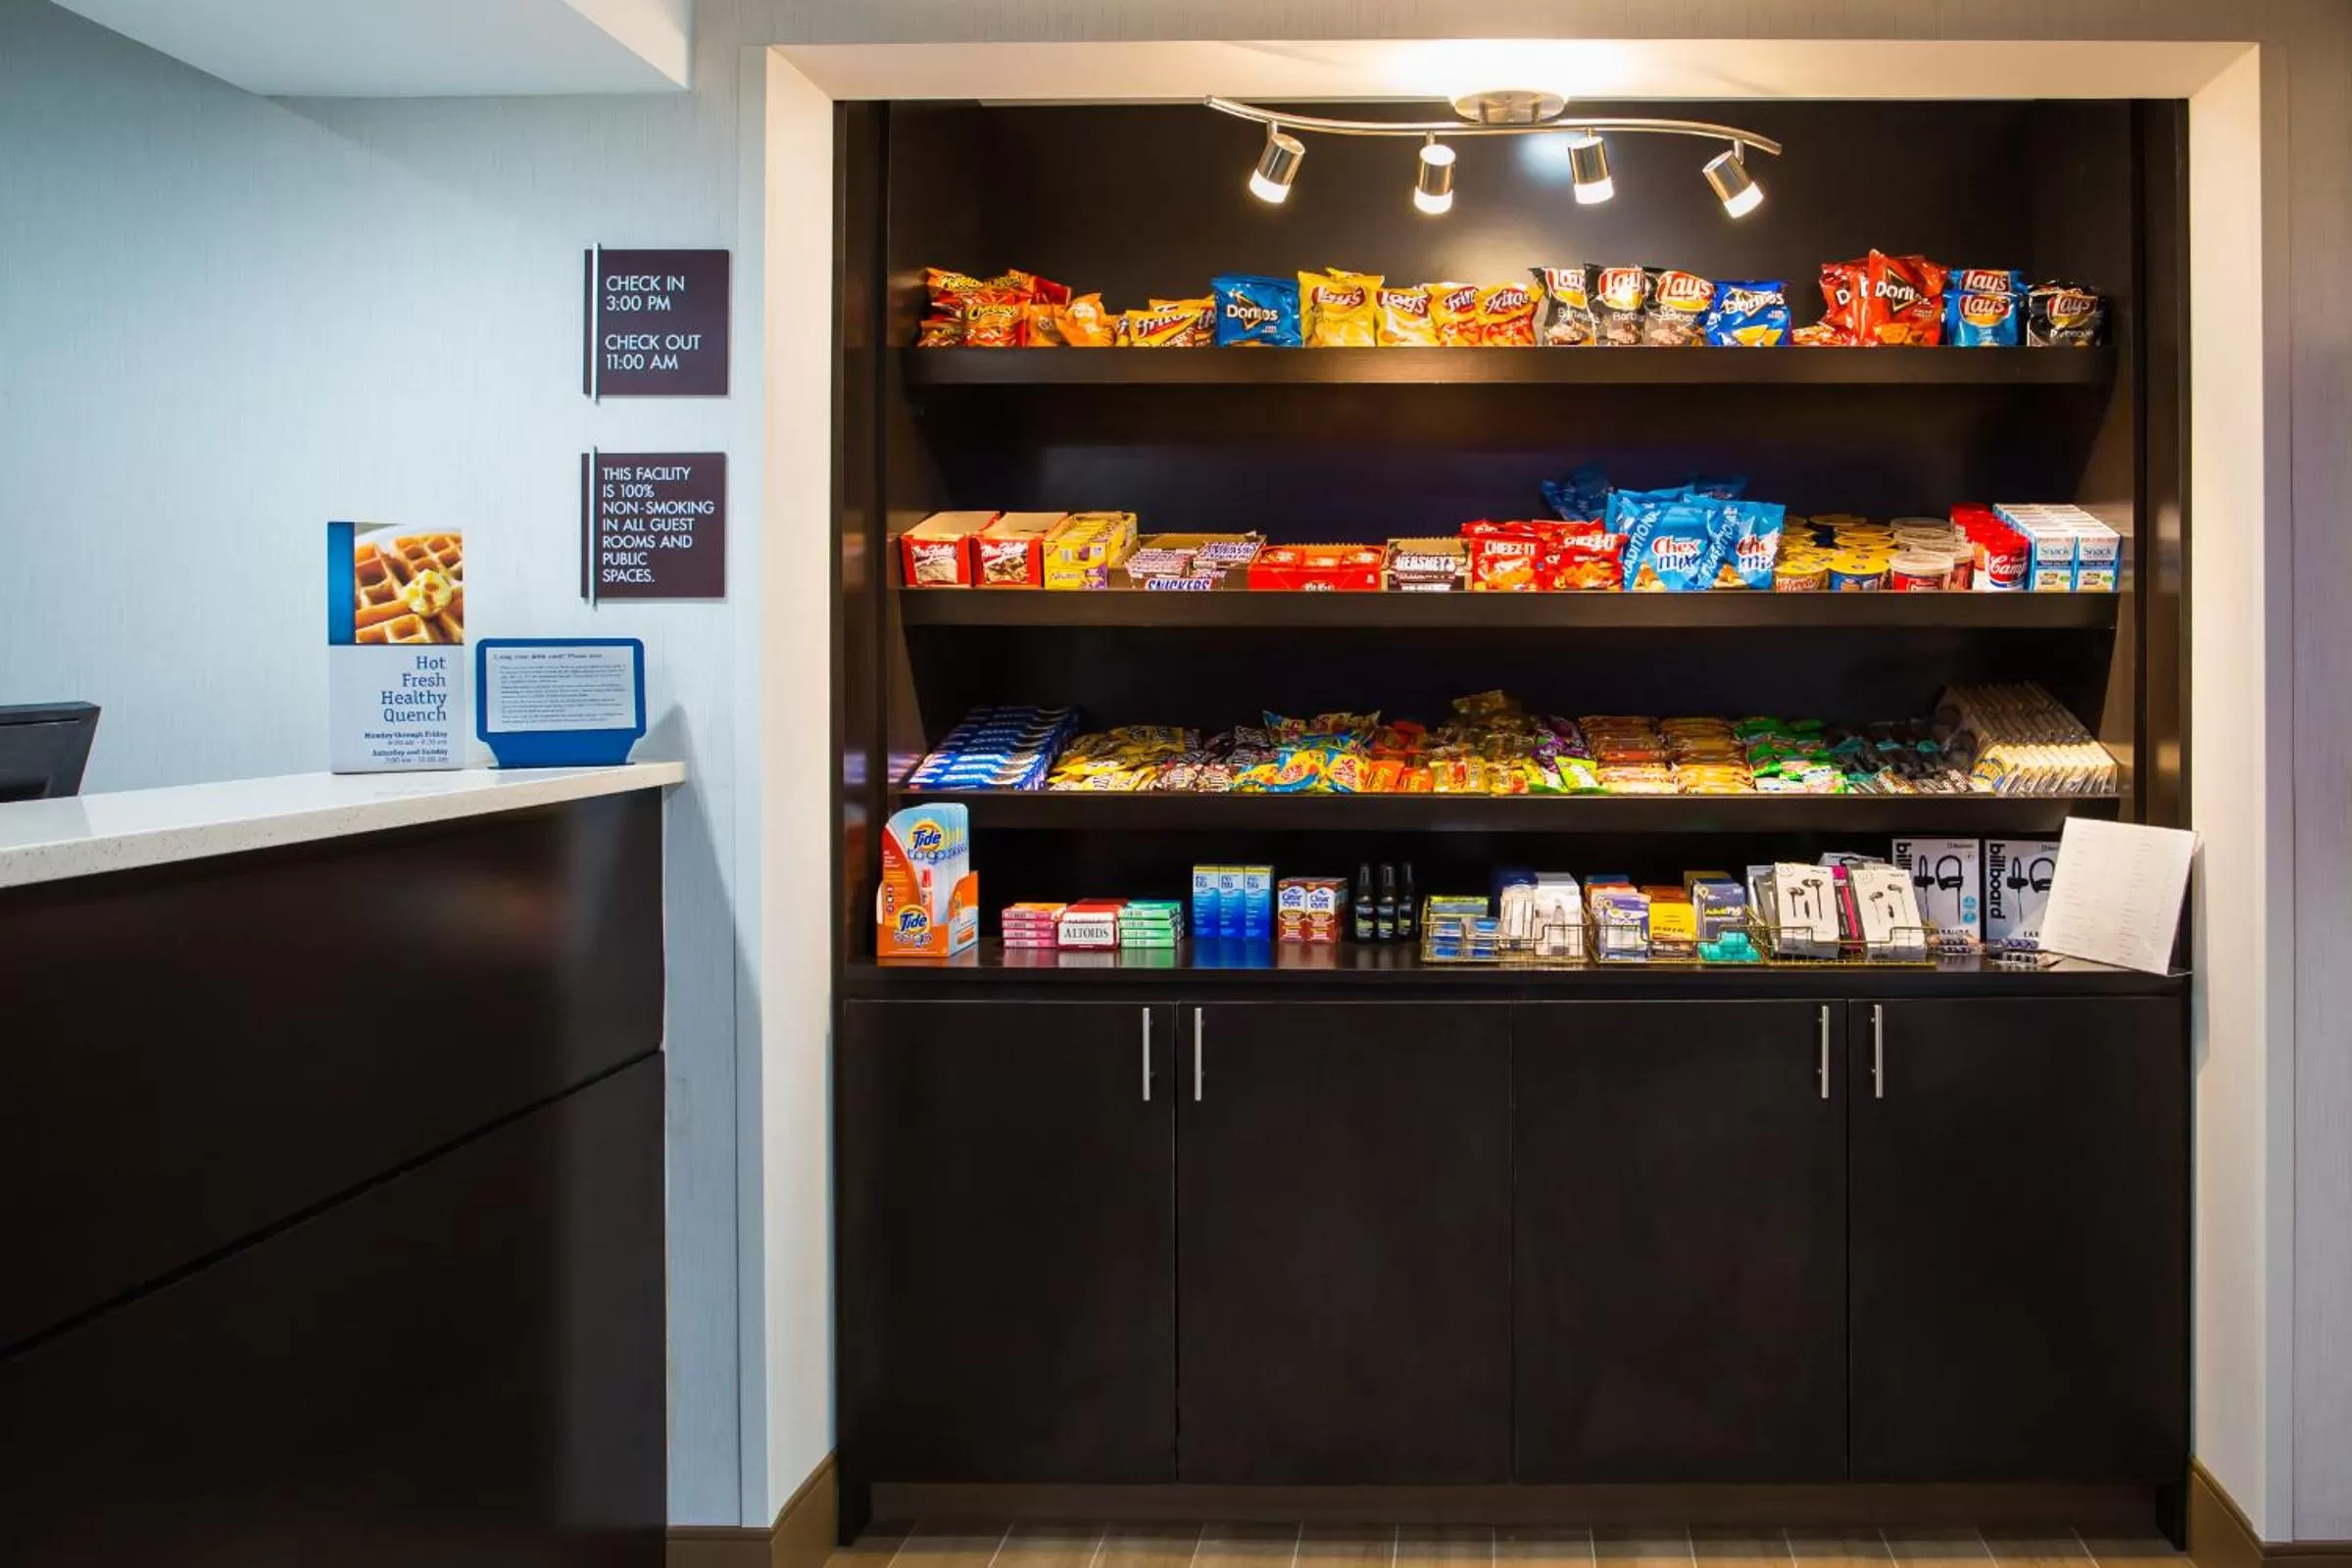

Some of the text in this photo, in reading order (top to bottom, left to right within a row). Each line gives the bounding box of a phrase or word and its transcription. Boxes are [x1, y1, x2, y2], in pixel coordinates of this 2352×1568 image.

[606, 275, 685, 291] CHECK IN
[606, 296, 671, 312] 3:00 PM
[1227, 305, 1278, 323] Doritos
[605, 334, 701, 350] CHECK OUT
[607, 354, 678, 369] 11:00 AM
[603, 466, 691, 480] THIS FACILITY
[603, 484, 655, 498] IS 100%
[603, 501, 714, 515] NON-SMOKING
[603, 517, 695, 532] IN ALL GUEST
[603, 535, 693, 549] ROOMS AND
[1652, 535, 1699, 555] Chex
[603, 552, 647, 566] PUBLIC
[603, 569, 655, 583] SPACES.
[1148, 579, 1211, 590] SNICKERS
[416, 656, 446, 670] Hot
[403, 673, 446, 687] Fresh
[381, 690, 447, 707] Healthy
[383, 707, 447, 723] Quench
[912, 828, 941, 850] Tide
[1989, 843, 2006, 919] billboard
[900, 913, 927, 931] Tide
[1064, 927, 1109, 940] ALTOIDS
